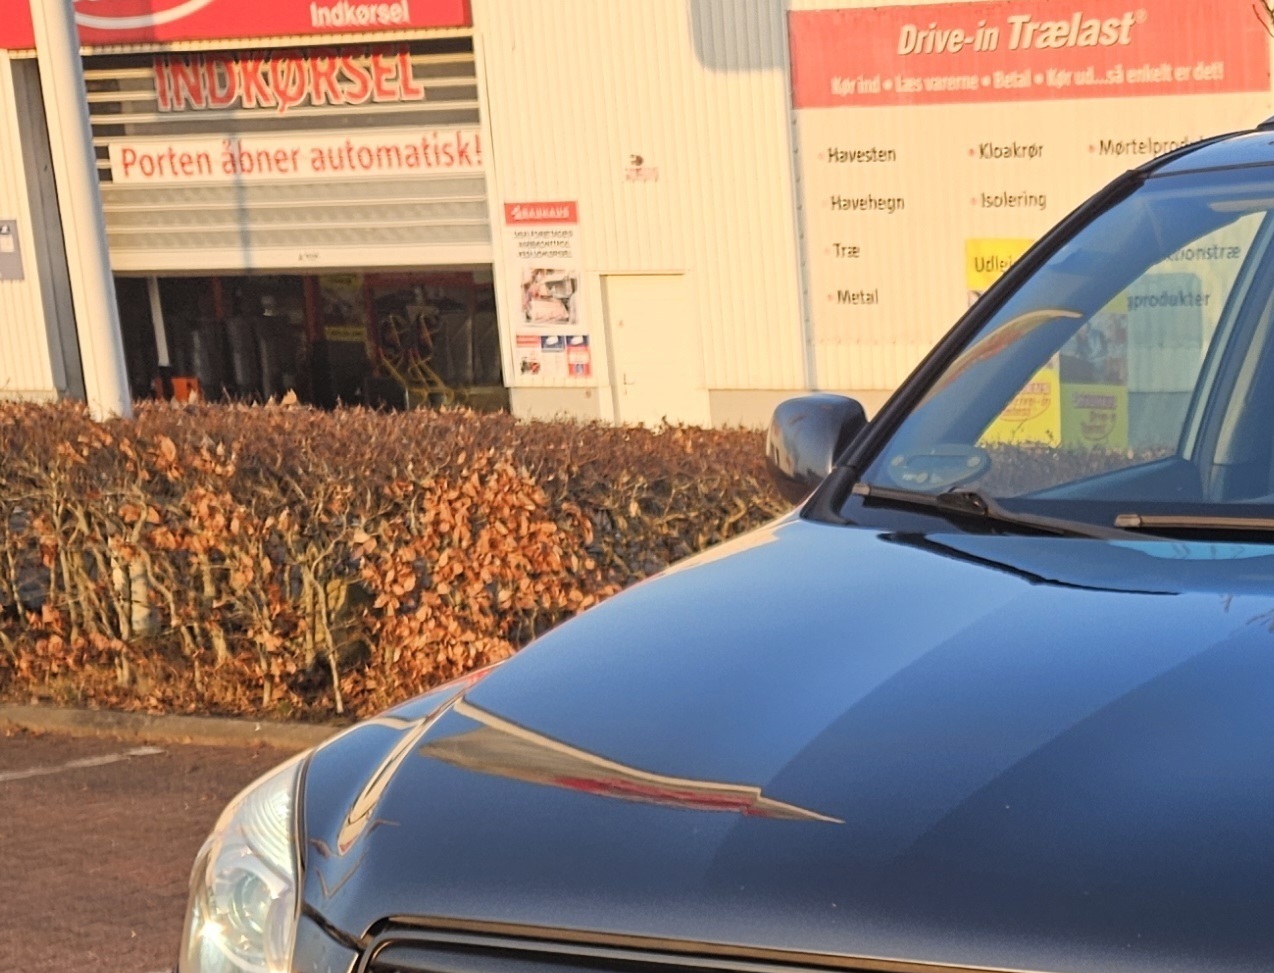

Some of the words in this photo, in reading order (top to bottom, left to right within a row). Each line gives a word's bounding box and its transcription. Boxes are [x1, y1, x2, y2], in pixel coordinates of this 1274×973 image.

[310, 0, 410, 28] Indkørsel
[897, 19, 1000, 56] Drive-in
[153, 44, 425, 114] INDKØRSEL
[1126, 63, 1172, 83] enkelt
[1174, 66, 1191, 81] er
[121, 147, 212, 179] Porten
[222, 138, 299, 175] åbner
[310, 130, 483, 173] automatisk!
[827, 146, 897, 164] Havesten
[978, 142, 1044, 161] Kloakrør
[831, 194, 905, 214] Havehegn
[980, 190, 1047, 210] Isolering
[833, 243, 861, 260] Træ
[837, 289, 879, 306] Metal
